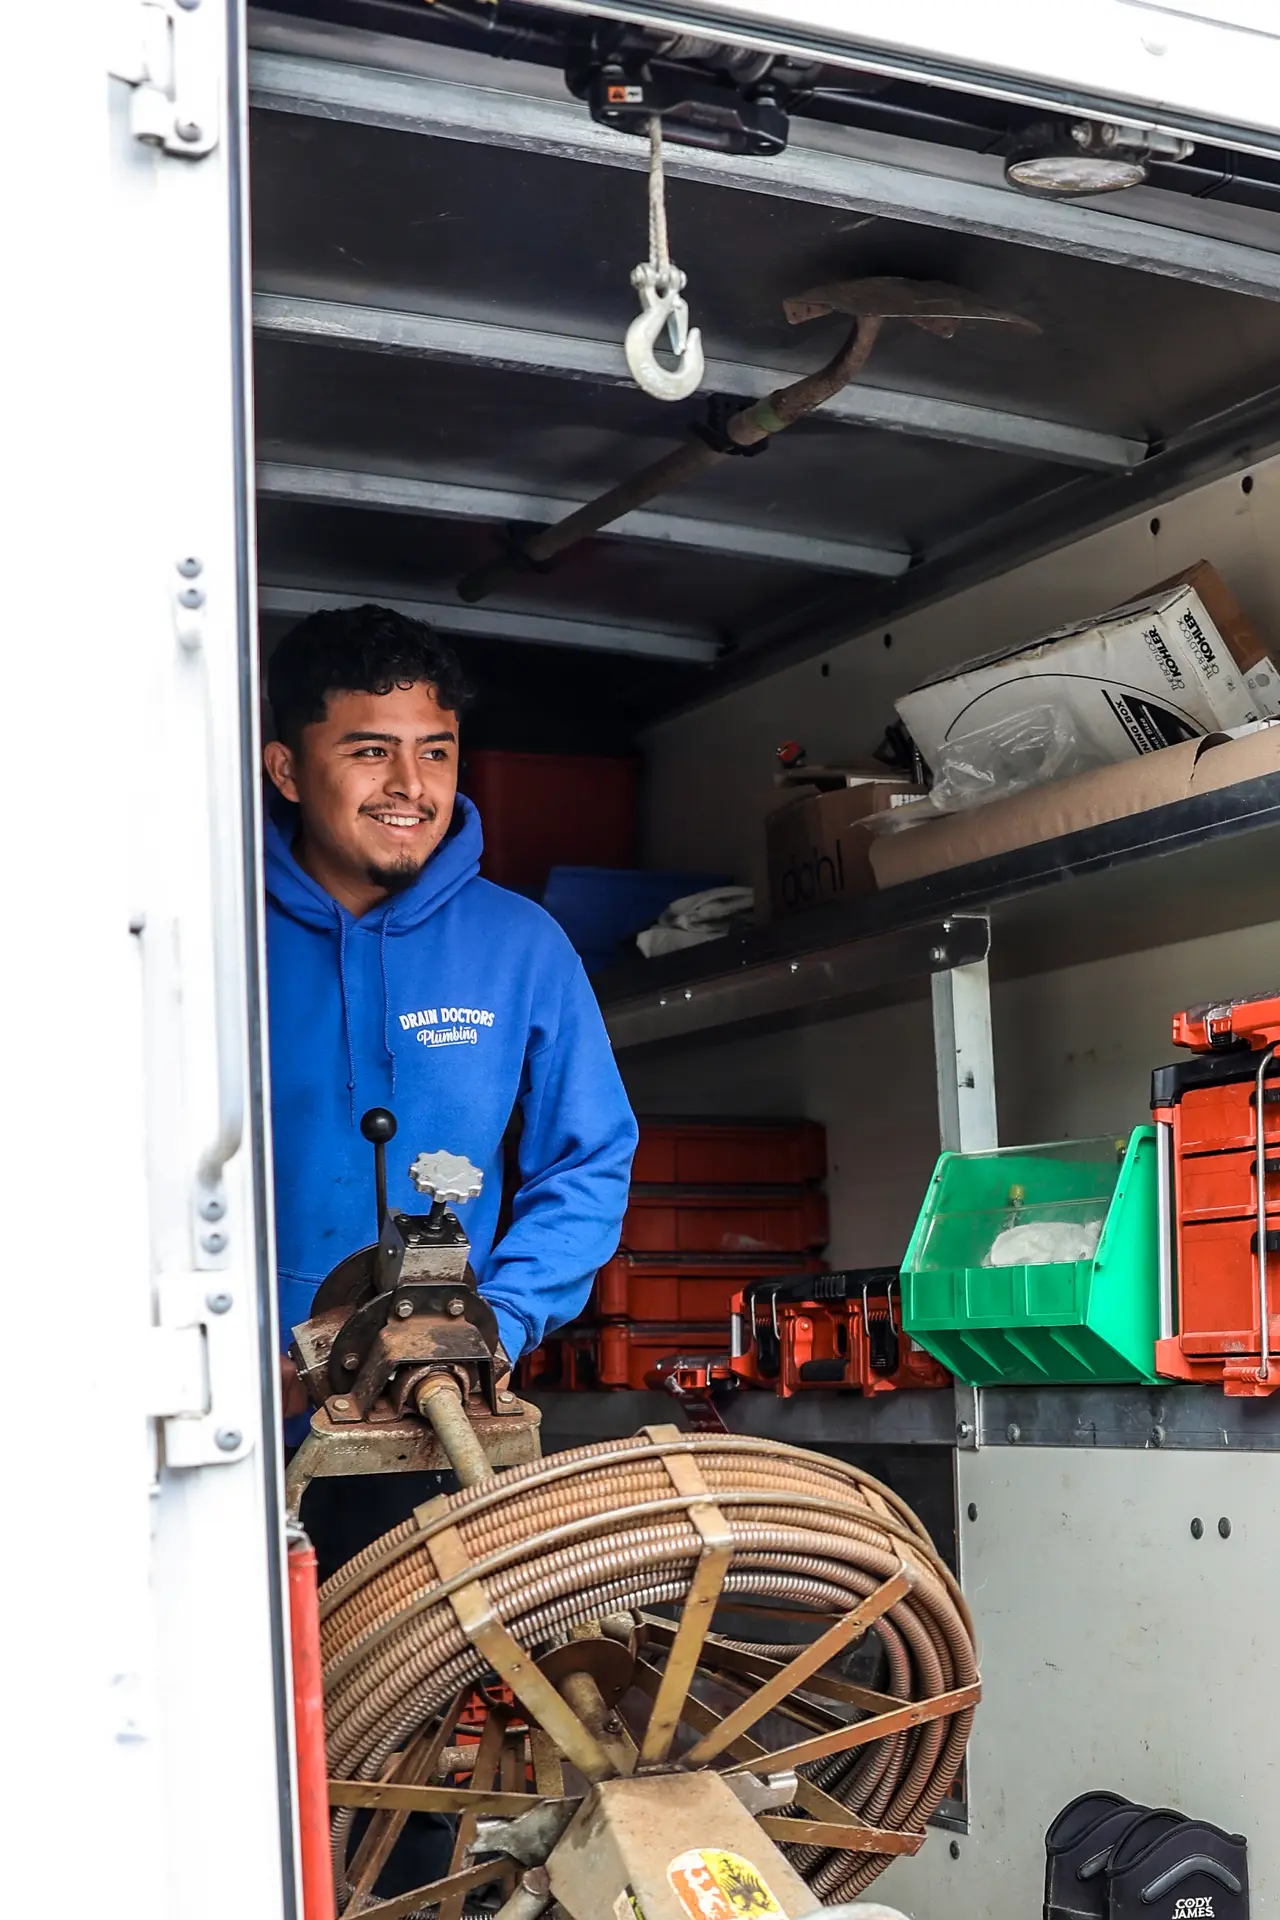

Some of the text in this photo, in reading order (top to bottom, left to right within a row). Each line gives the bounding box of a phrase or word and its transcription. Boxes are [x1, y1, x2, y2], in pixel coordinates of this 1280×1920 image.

[1176, 616, 1214, 680] THE BOLD LOOK
[1141, 630, 1179, 691] THE BOLD LOOK
[1209, 662, 1220, 674] OF
[1176, 678, 1185, 690] OF
[1115, 700, 1133, 724] BOX
[399, 1007, 495, 1030] DRAIN DOCTORS
[416, 1025, 478, 1046] Plumbing
[1171, 1906, 1214, 1920] JAMES
[1175, 1896, 1213, 1909] CODY
